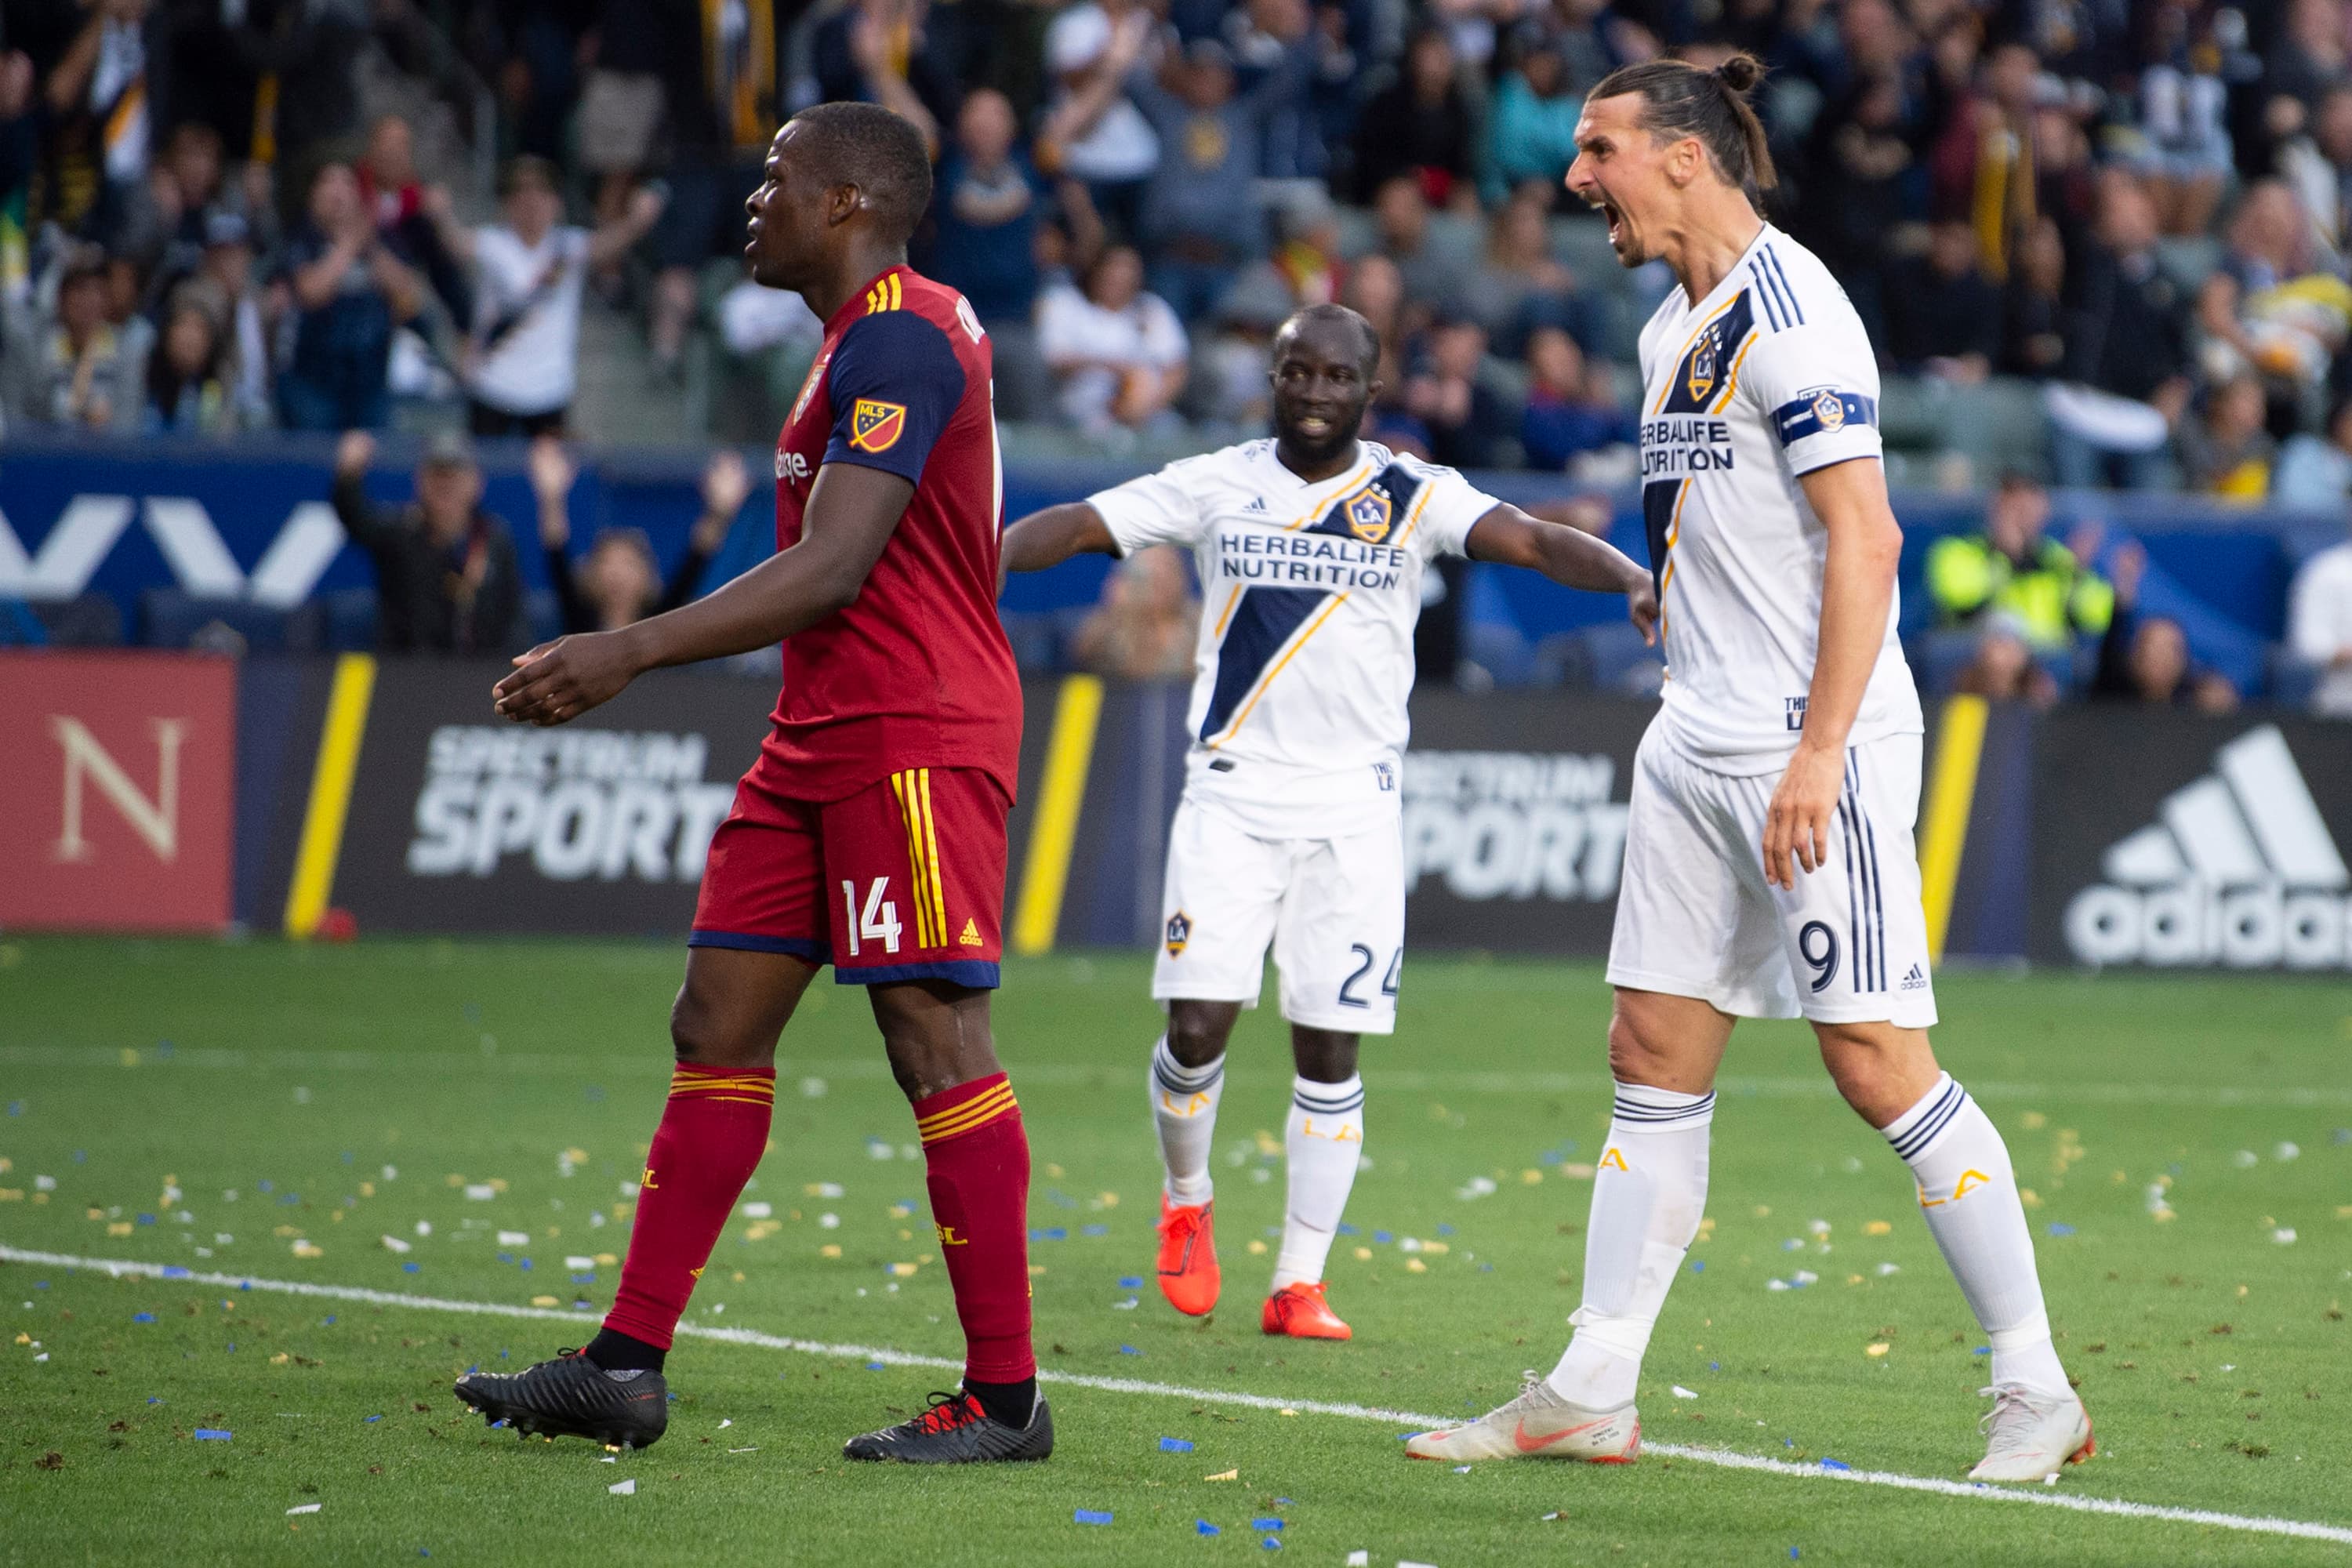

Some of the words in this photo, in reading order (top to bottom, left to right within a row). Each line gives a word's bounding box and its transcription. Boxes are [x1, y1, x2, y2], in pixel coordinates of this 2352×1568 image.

[1696, 361, 1711, 376] LA
[860, 405, 885, 418] MLS
[1357, 509, 1383, 524] LA
[1221, 533, 1404, 568] HERBALIFE
[1223, 558, 1400, 590] NUTRITION
[430, 728, 708, 779] SPECTRUM
[44, 714, 194, 863] N
[842, 877, 902, 956] 14
[1169, 926, 1186, 941] LA
[1800, 920, 1841, 993] 9
[1338, 942, 1402, 1009] 24
[1162, 1091, 1211, 1116] LA
[1304, 1117, 1363, 1142] LA
[1919, 1169, 1991, 1207] LA
